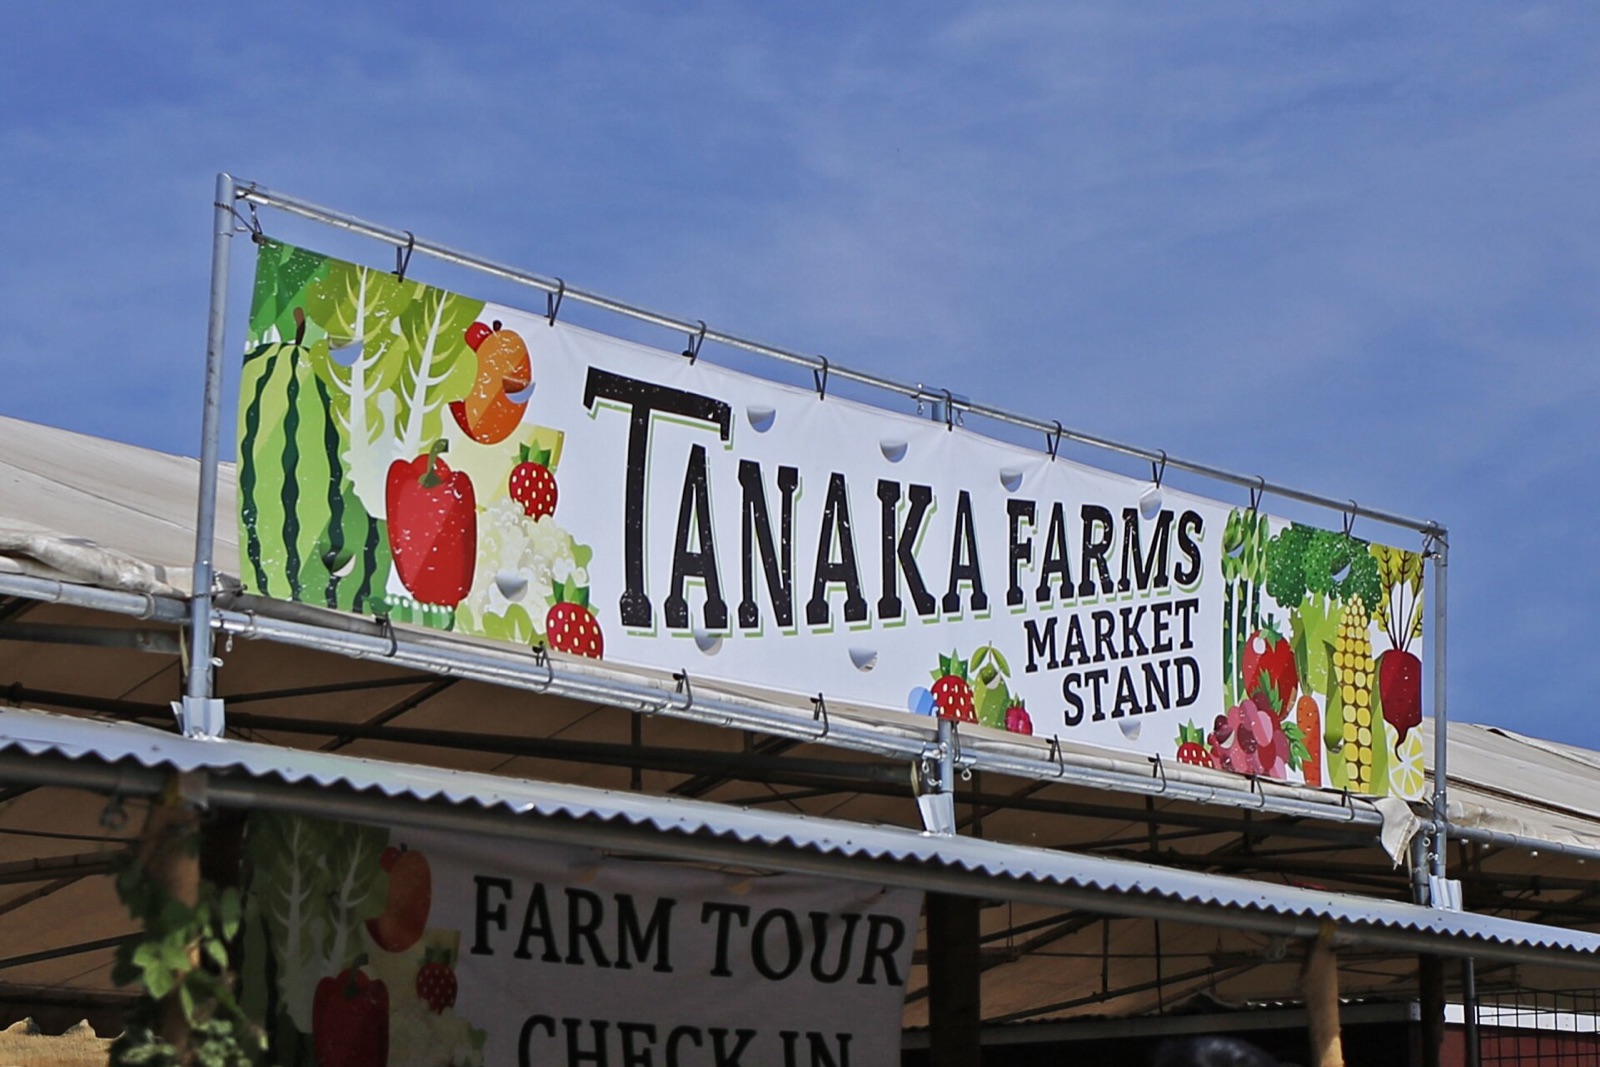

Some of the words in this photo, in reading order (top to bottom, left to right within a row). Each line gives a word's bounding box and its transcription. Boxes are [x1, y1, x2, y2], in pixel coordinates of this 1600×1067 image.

[583, 366, 988, 629] TANAKA
[1006, 499, 1204, 606] FARMS
[1024, 598, 1199, 673] MARKET
[1063, 656, 1201, 727] STAND
[470, 875, 677, 973] FARM
[701, 900, 906, 987] TOUR
[518, 1014, 757, 1067] CHECK
